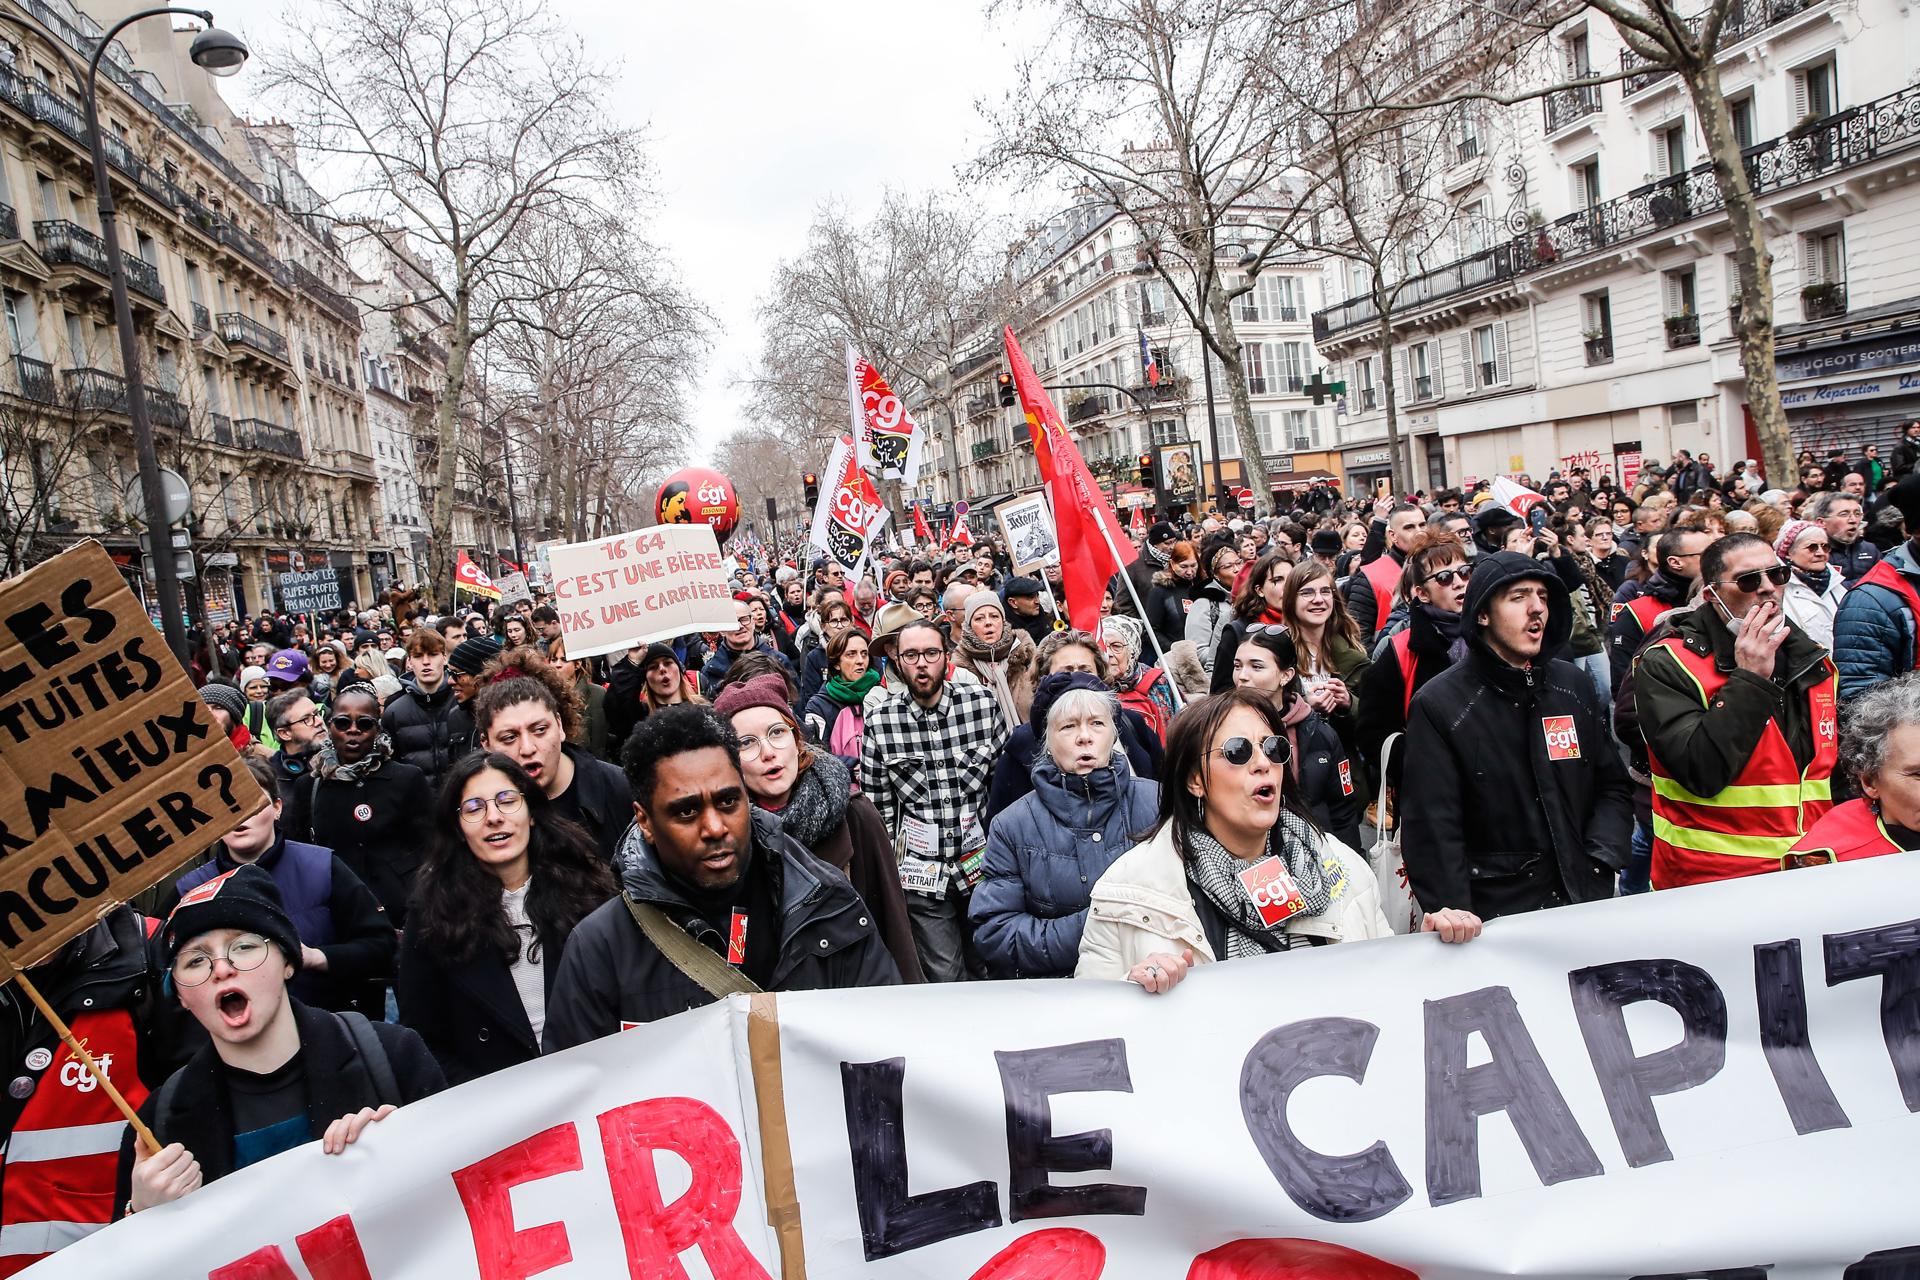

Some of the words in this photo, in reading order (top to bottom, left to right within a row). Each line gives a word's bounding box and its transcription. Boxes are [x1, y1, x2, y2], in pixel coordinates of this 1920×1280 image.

[1782, 353, 1856, 373] PEUGEOT
[1813, 383, 1880, 402] Réparation
[697, 485, 728, 505] cgt
[1173, 485, 1195, 496] Crime
[702, 507, 727, 516] ESSONNE
[708, 516, 722, 526] 91
[600, 539, 628, 561] 16
[635, 532, 666, 555] 64
[322, 569, 336, 580] LES
[555, 569, 619, 599] C'EST
[624, 559, 665, 585] UNE
[283, 581, 340, 598] SUPER-PROFITS
[466, 584, 493, 596] PARIS
[285, 600, 298, 611] PAS
[299, 598, 316, 608] NOS
[561, 609, 595, 634] PAS
[601, 600, 641, 625] UNE
[1547, 727, 1578, 749] cgt
[1568, 748, 1579, 757] 93
[358, 807, 369, 817] 60
[908, 874, 936, 887] RETRAIT
[1251, 871, 1297, 908] cgt
[1287, 897, 1306, 913] 93
[60, 1053, 112, 1093] cgt
[840, 1037, 1147, 1262] LE
[1239, 918, 1920, 1223] CAPIT
